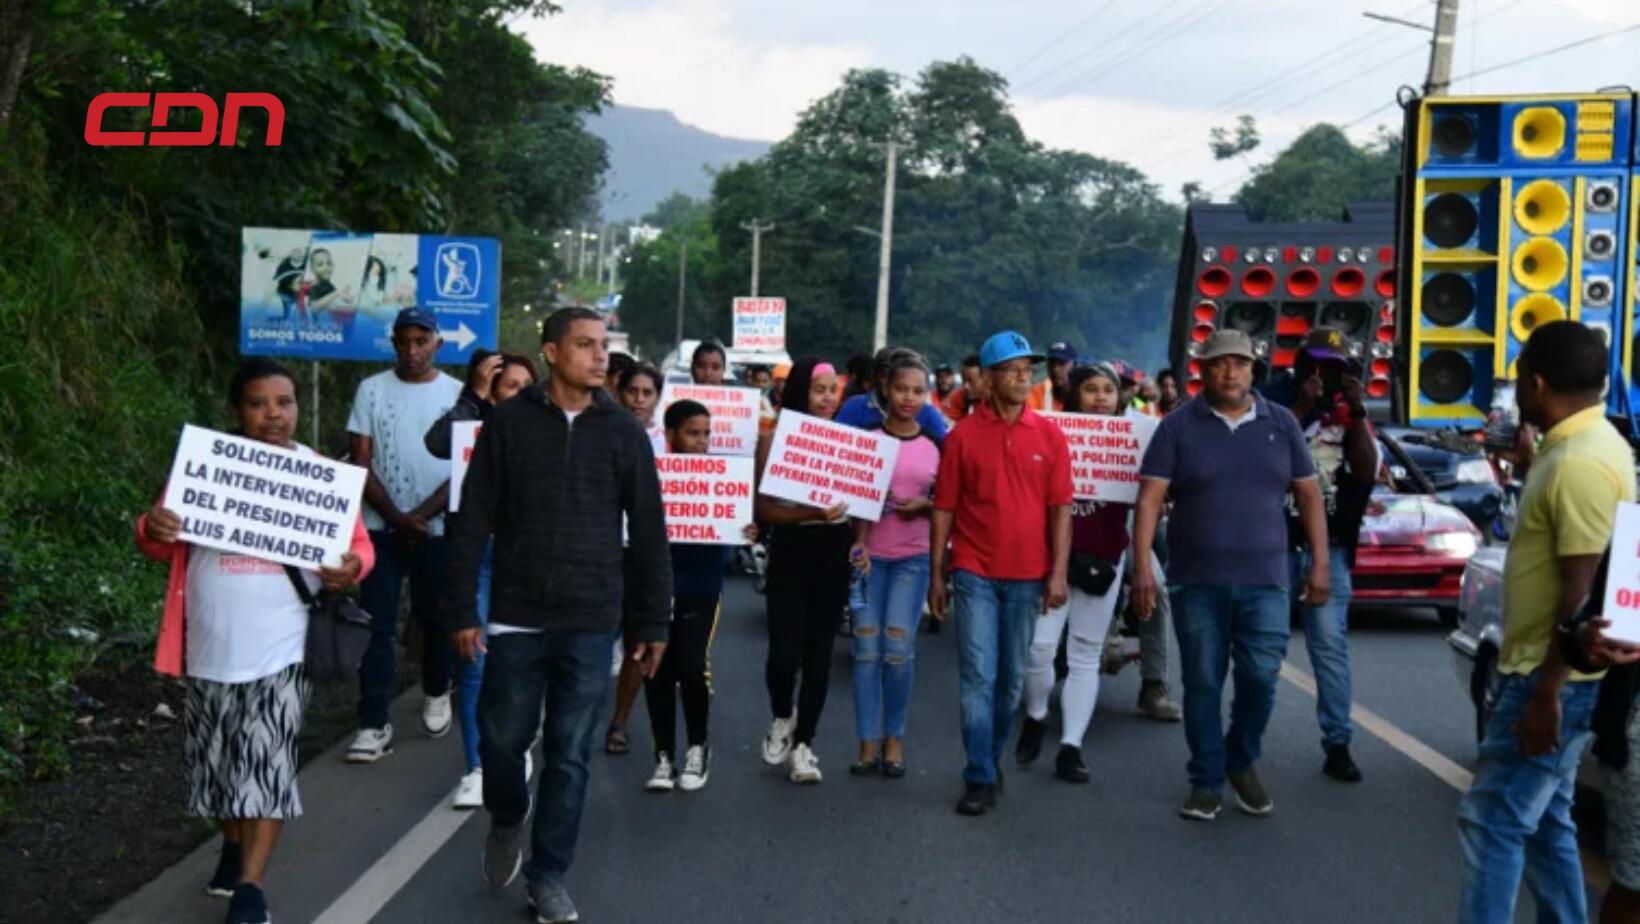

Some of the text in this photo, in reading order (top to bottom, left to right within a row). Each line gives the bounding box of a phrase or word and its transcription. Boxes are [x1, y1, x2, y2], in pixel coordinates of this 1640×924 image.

[248, 328, 344, 343] SOMOS TODOS
[801, 421, 878, 452] EXIGIMOS QUE
[1107, 421, 1132, 435] QUE
[784, 434, 884, 471] BARRICK CUMPLA
[1088, 435, 1140, 451] CUMPLA
[211, 439, 336, 483] SOLICITAMOS
[655, 456, 727, 475] XIGIMOS
[783, 449, 809, 466] CON
[809, 456, 823, 471] LA
[768, 462, 881, 503] OPERATIVA MUNDIAL
[1092, 467, 1142, 483] MUNDIA
[184, 460, 350, 515] LA INTERVENCIÓN
[661, 477, 750, 498] USIÓN CON
[182, 487, 340, 539] DEL PRESIDENTE
[663, 501, 737, 520] TERIO DE
[182, 516, 326, 564] LUIS ABINADER
[666, 523, 721, 540] STICIA.
